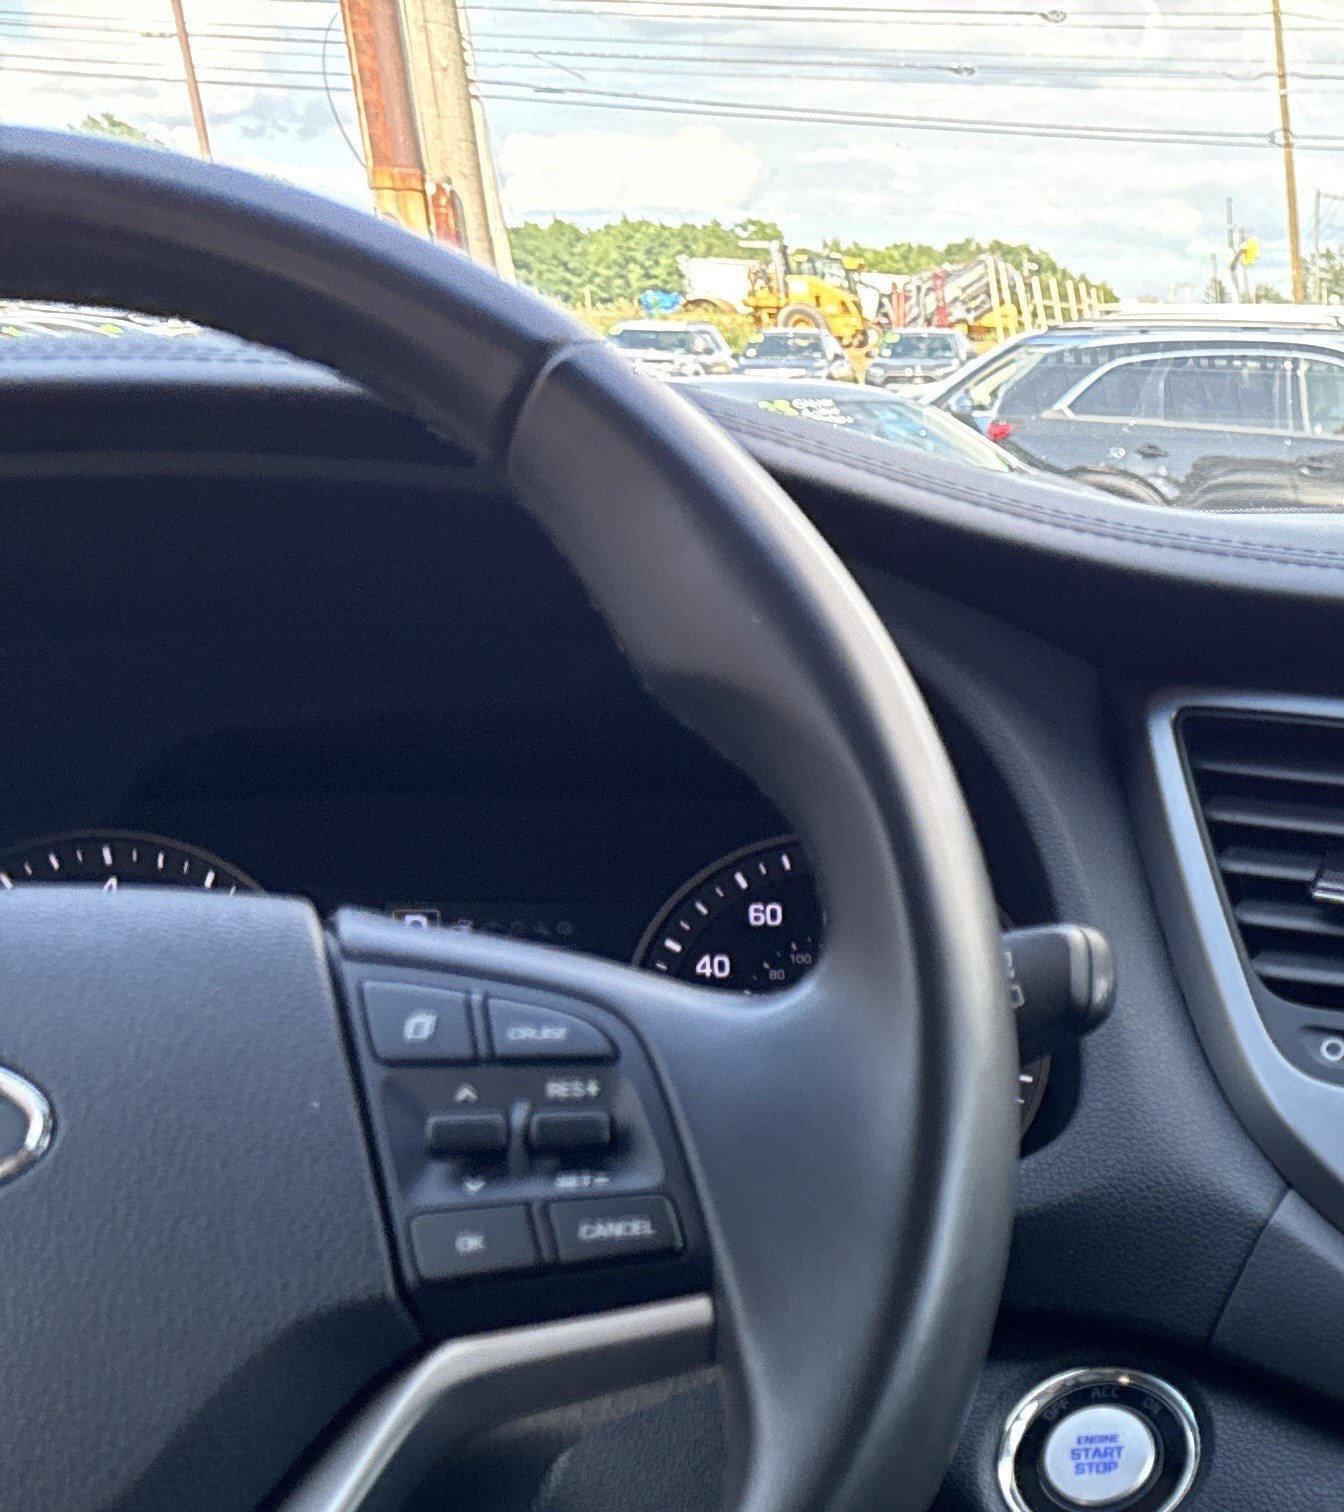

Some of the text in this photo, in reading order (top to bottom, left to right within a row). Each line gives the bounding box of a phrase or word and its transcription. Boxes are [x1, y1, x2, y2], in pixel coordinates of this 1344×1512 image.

[748, 902, 783, 927] 60
[695, 954, 731, 978] 40
[577, 1219, 656, 1240] CANCEL
[1077, 1434, 1119, 1444] ENGINE
[1070, 1446, 1124, 1460] START
[1074, 1461, 1119, 1475] STOP
